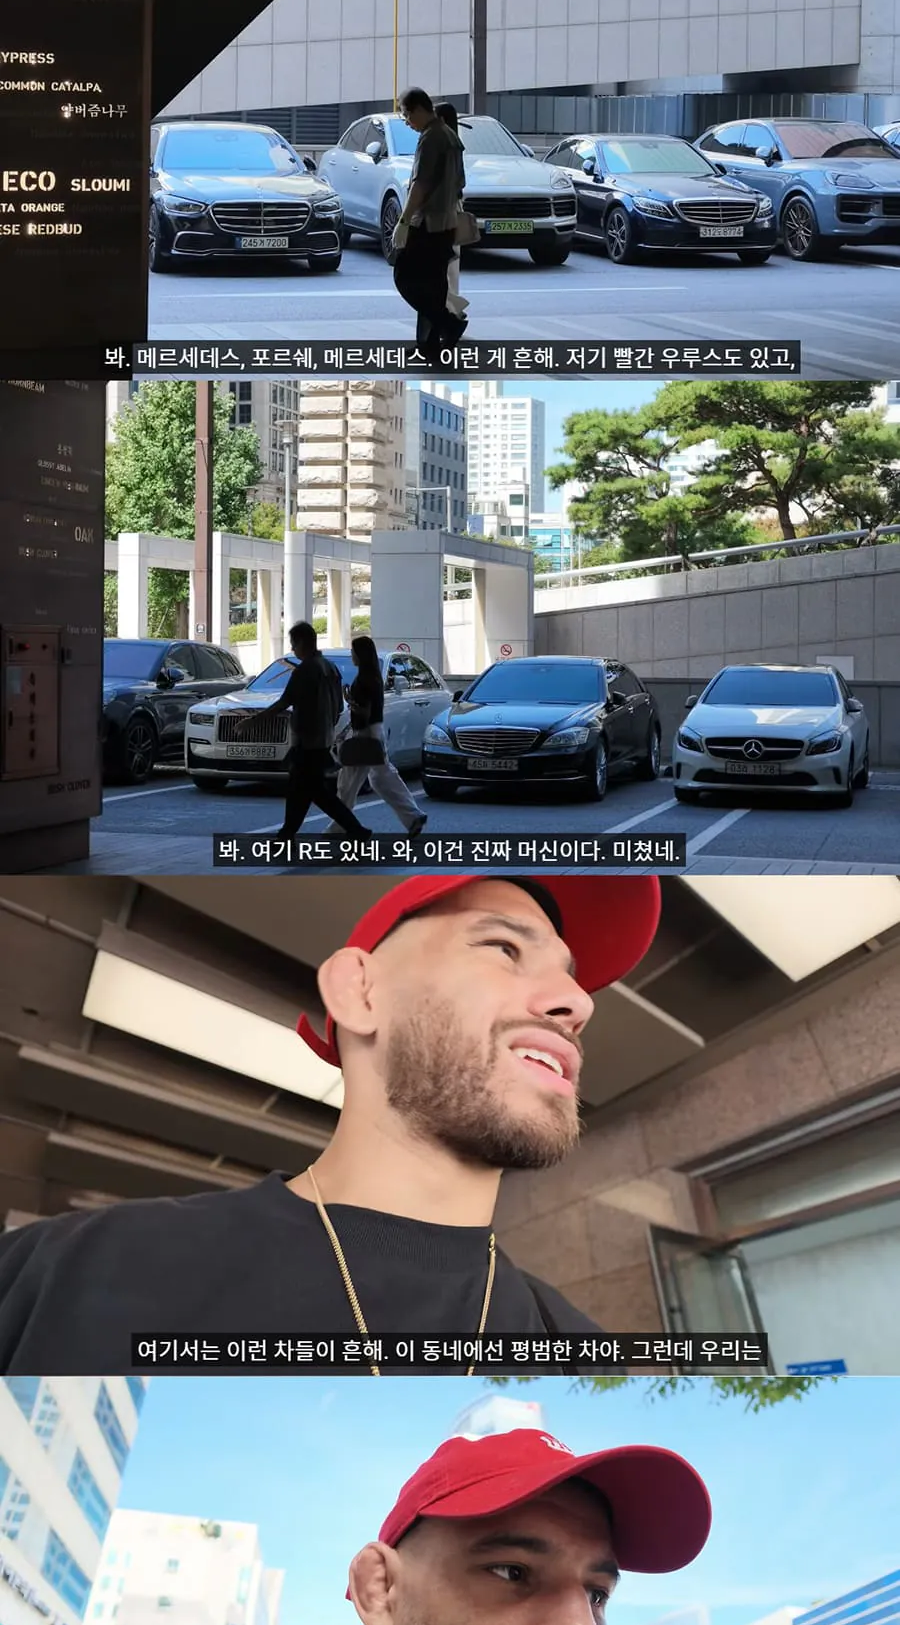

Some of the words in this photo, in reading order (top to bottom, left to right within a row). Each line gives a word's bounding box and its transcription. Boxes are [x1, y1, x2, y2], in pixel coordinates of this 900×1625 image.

[0, 51, 55, 66] YPRESS
[50, 80, 102, 93] CATALPA
[2, 170, 56, 192] ECO
[70, 178, 131, 192] SLOUMI
[20, 202, 65, 213] ORANGE
[26, 222, 83, 236] REDBUD
[74, 526, 95, 544] OAK
